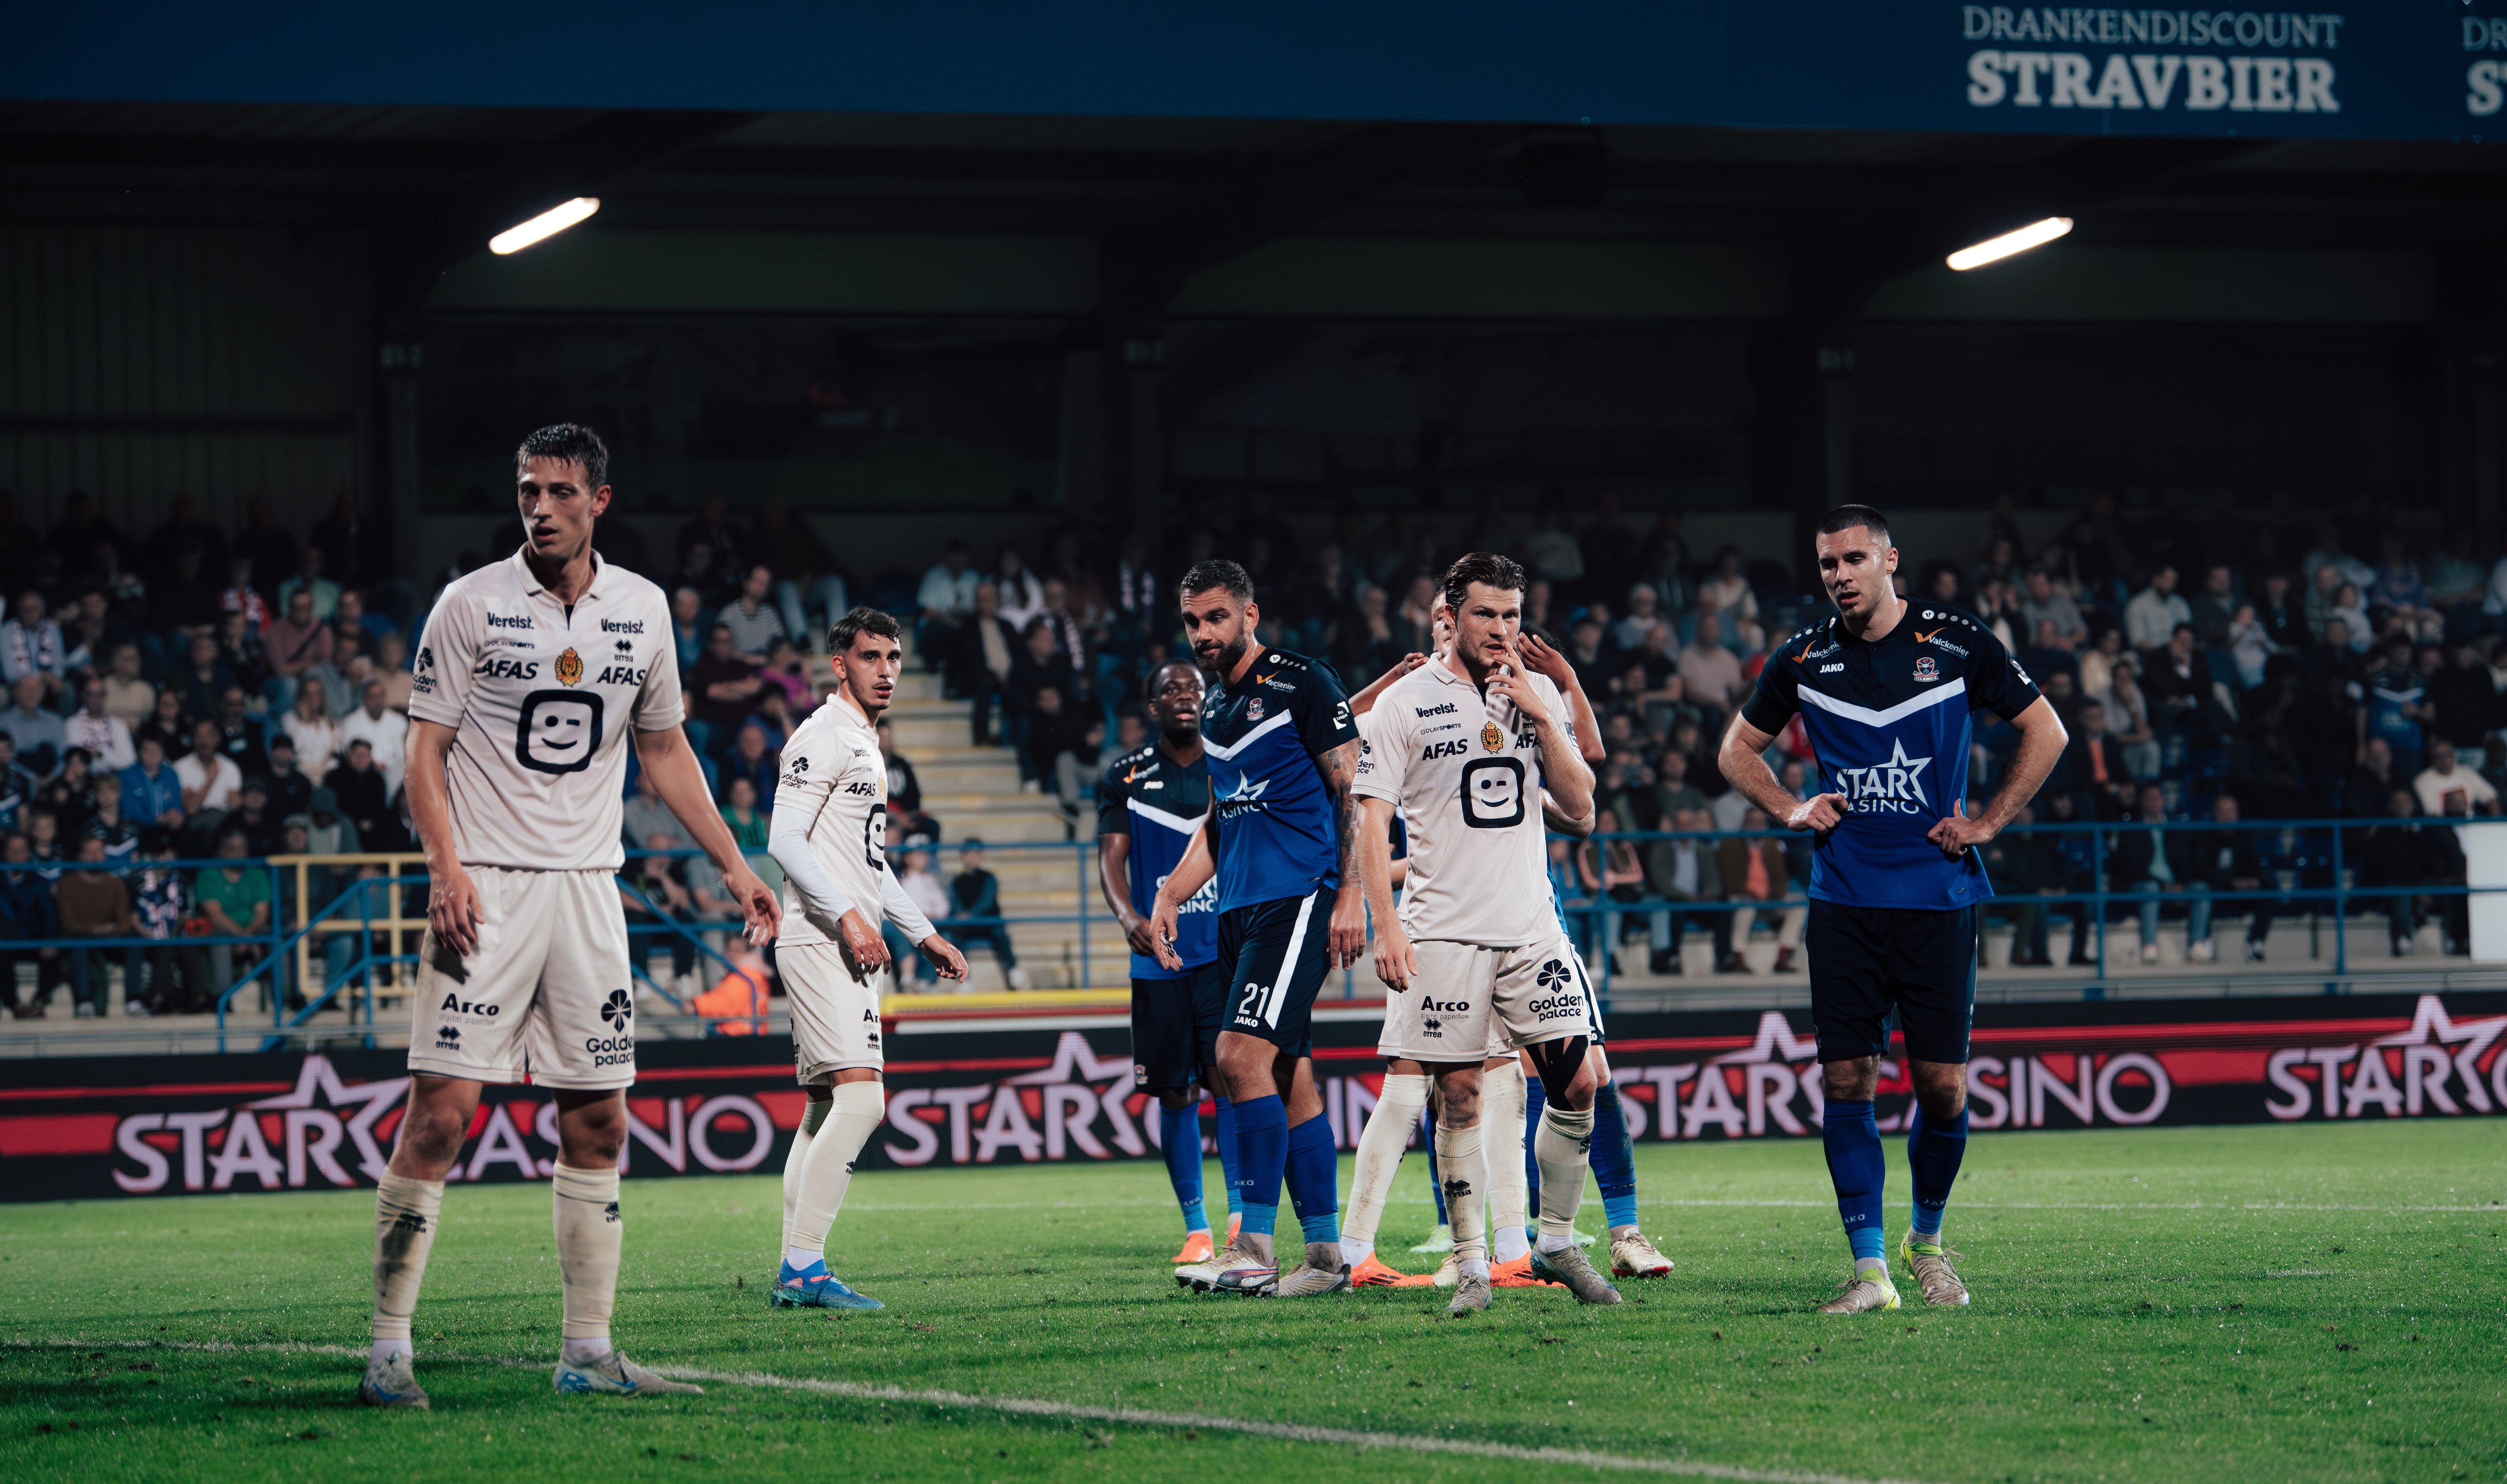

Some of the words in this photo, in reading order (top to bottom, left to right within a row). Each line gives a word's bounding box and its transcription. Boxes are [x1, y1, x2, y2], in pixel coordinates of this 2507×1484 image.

[1962, 5, 2342, 48] DRANKENDISCOUNT
[1967, 49, 2340, 112] STRAVBIER
[1806, 641, 1844, 658] Valckeni
[1929, 636, 1969, 656] Valckenier
[482, 659, 539, 679] AFAS
[596, 666, 646, 686] AFAS
[1819, 663, 1844, 673] JAKO
[1416, 702, 1458, 718] Verelst.
[1422, 738, 1468, 761] AFAS
[1514, 733, 1541, 749] AFA
[1356, 760, 1374, 769] den
[844, 782, 876, 796] AFAS
[1836, 767, 1913, 800] STAR
[1847, 799, 1919, 814] ASINO
[1176, 899, 1216, 914] SINO
[440, 993, 499, 1016] Arco
[1238, 983, 1269, 1018] 21
[1421, 995, 1470, 1012] Arco
[1529, 994, 1584, 1013] Golden
[863, 1009, 882, 1026] Ar
[1234, 1016, 1258, 1027] JAKO
[1539, 1008, 1581, 1023] palace
[586, 1034, 634, 1053] Golde
[2264, 1043, 2463, 1120] STAR
[1875, 1052, 2171, 1132] SINO
[884, 1086, 1113, 1166] STAR
[113, 1108, 357, 1193] STAR
[1923, 1199, 1947, 1207] JAK
[1844, 1214, 1865, 1223] AKO
